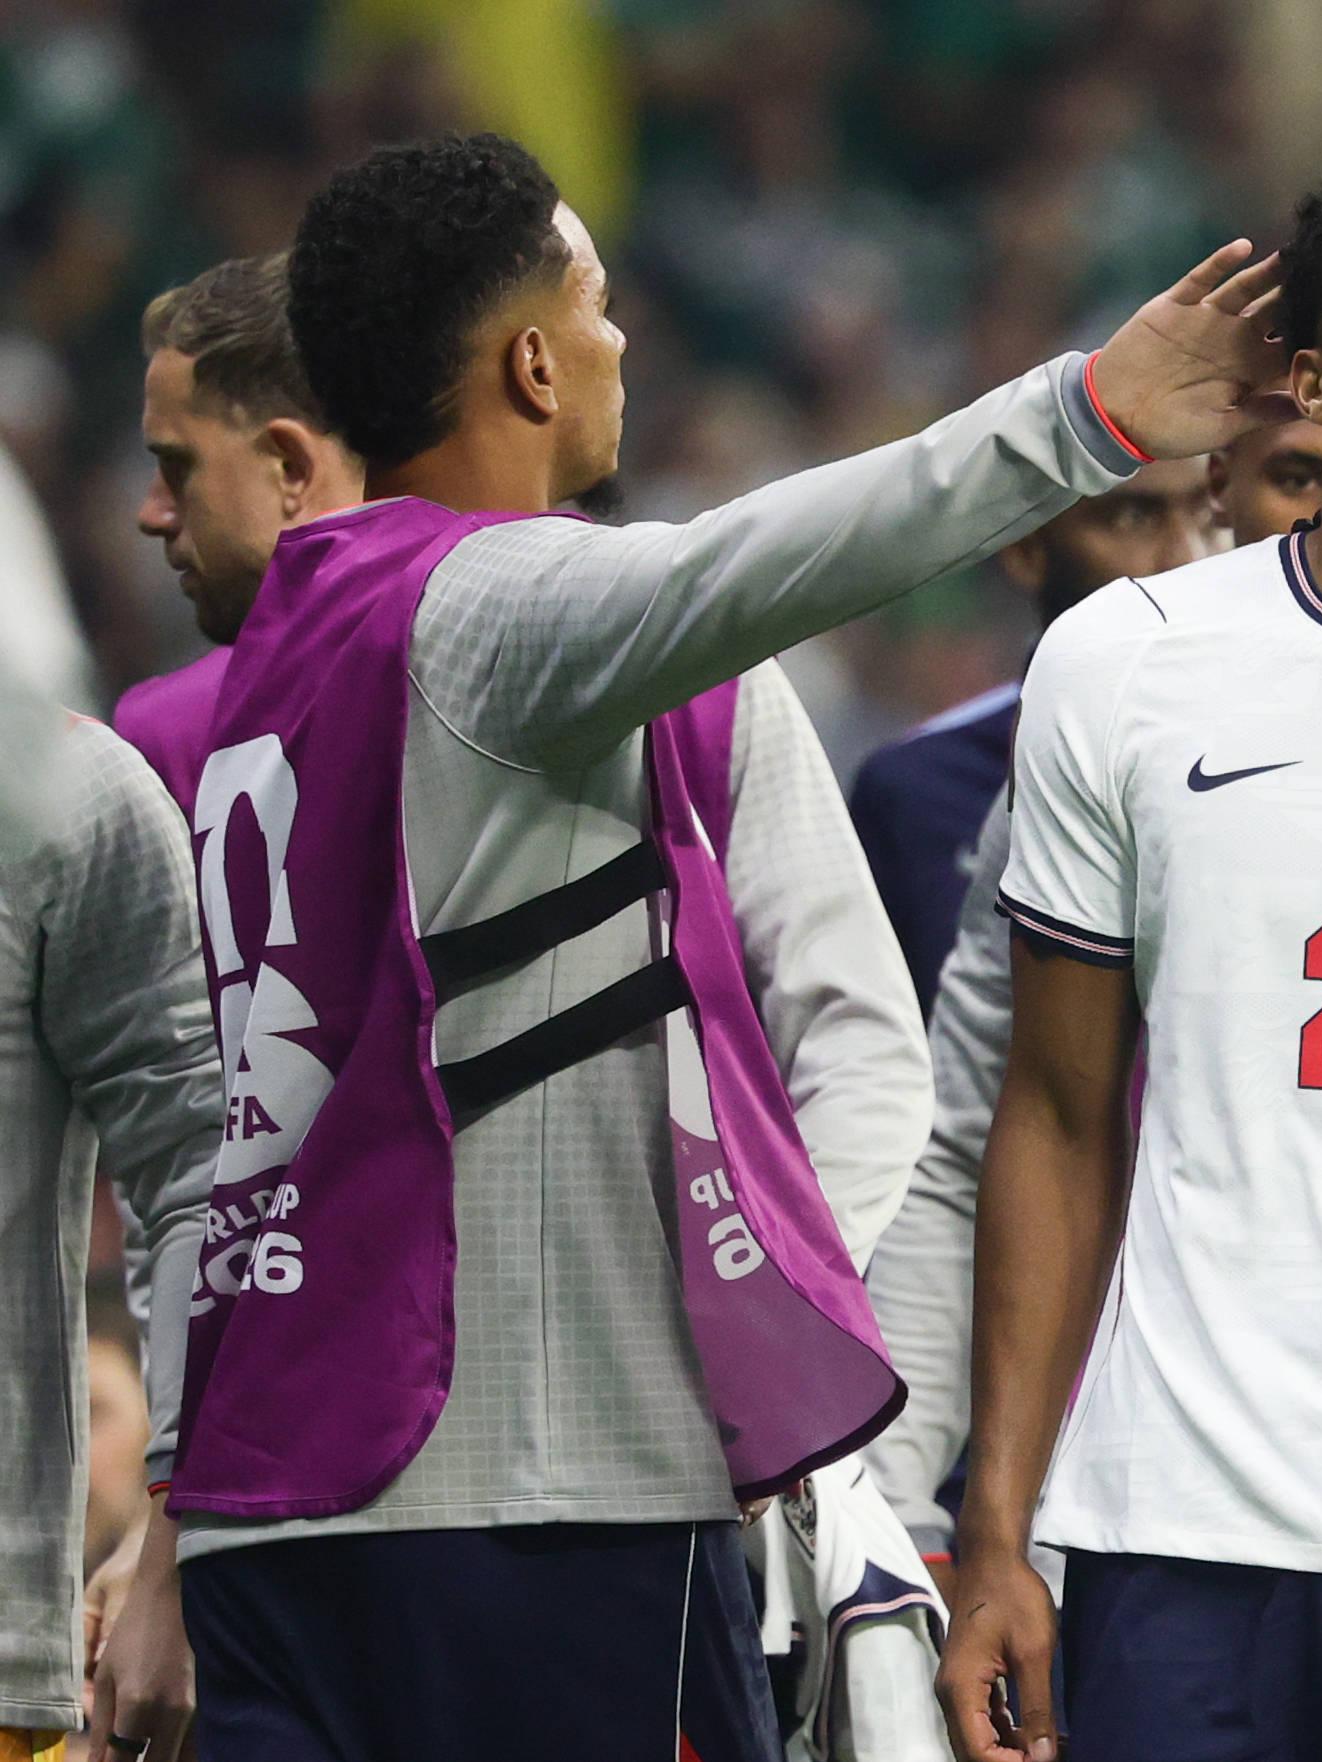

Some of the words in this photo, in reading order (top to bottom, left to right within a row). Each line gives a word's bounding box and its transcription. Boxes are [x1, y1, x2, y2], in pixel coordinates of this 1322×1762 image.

[226, 1096, 283, 1141] FA
[206, 1189, 275, 1244] RLD
[265, 1183, 300, 1220] UP
